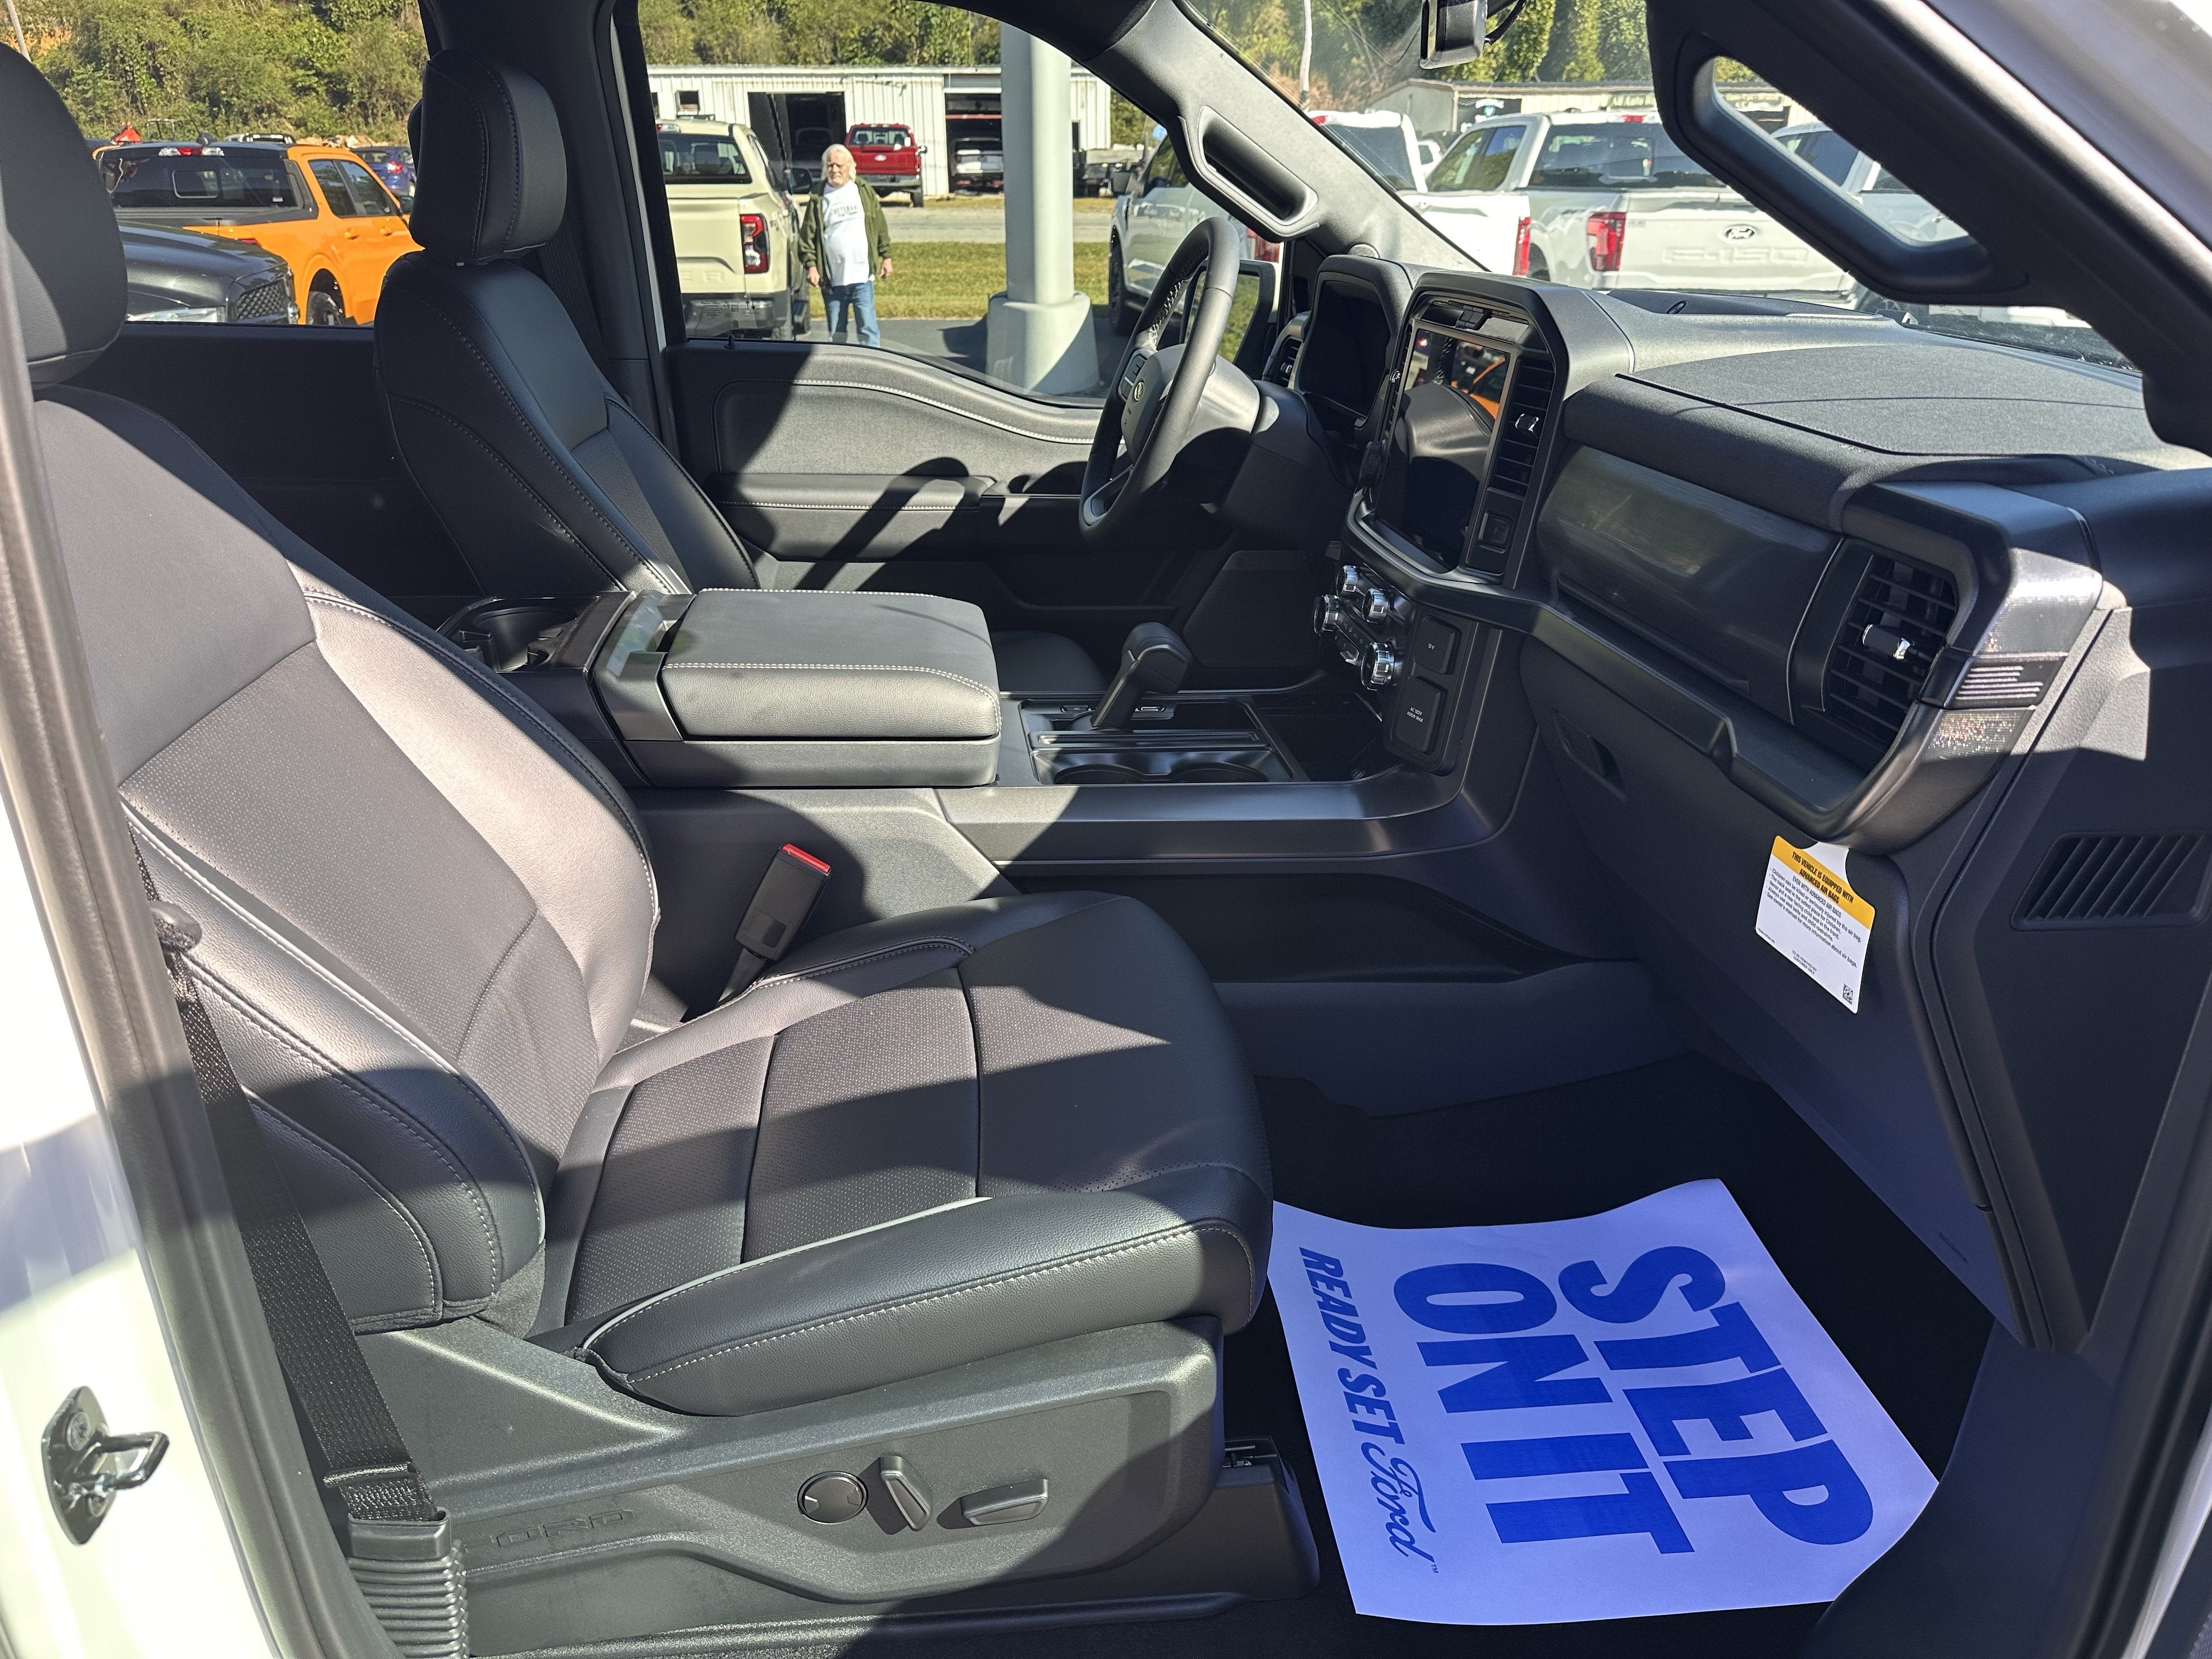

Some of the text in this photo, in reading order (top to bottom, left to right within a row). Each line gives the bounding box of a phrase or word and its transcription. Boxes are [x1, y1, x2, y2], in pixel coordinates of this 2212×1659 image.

[1662, 247, 1809, 263] F-150
[1792, 851, 1854, 904] THIS VEHICLE IS EQUIPPED WITH
[1792, 876, 1801, 886] EVEN
[1801, 882, 1809, 893] WITH
[1809, 889, 1826, 906] ADVANCED
[1832, 906, 1841, 918] BAGS
[1799, 868, 1839, 904] ADVANCED AIR BAGS
[1299, 1246, 1378, 1370] READY
[1338, 1368, 1405, 1444] SET
[1393, 1263, 1695, 1554] ON IT
[1558, 1245, 1873, 1545] STEP
[1361, 1442, 1436, 1563] Ford
